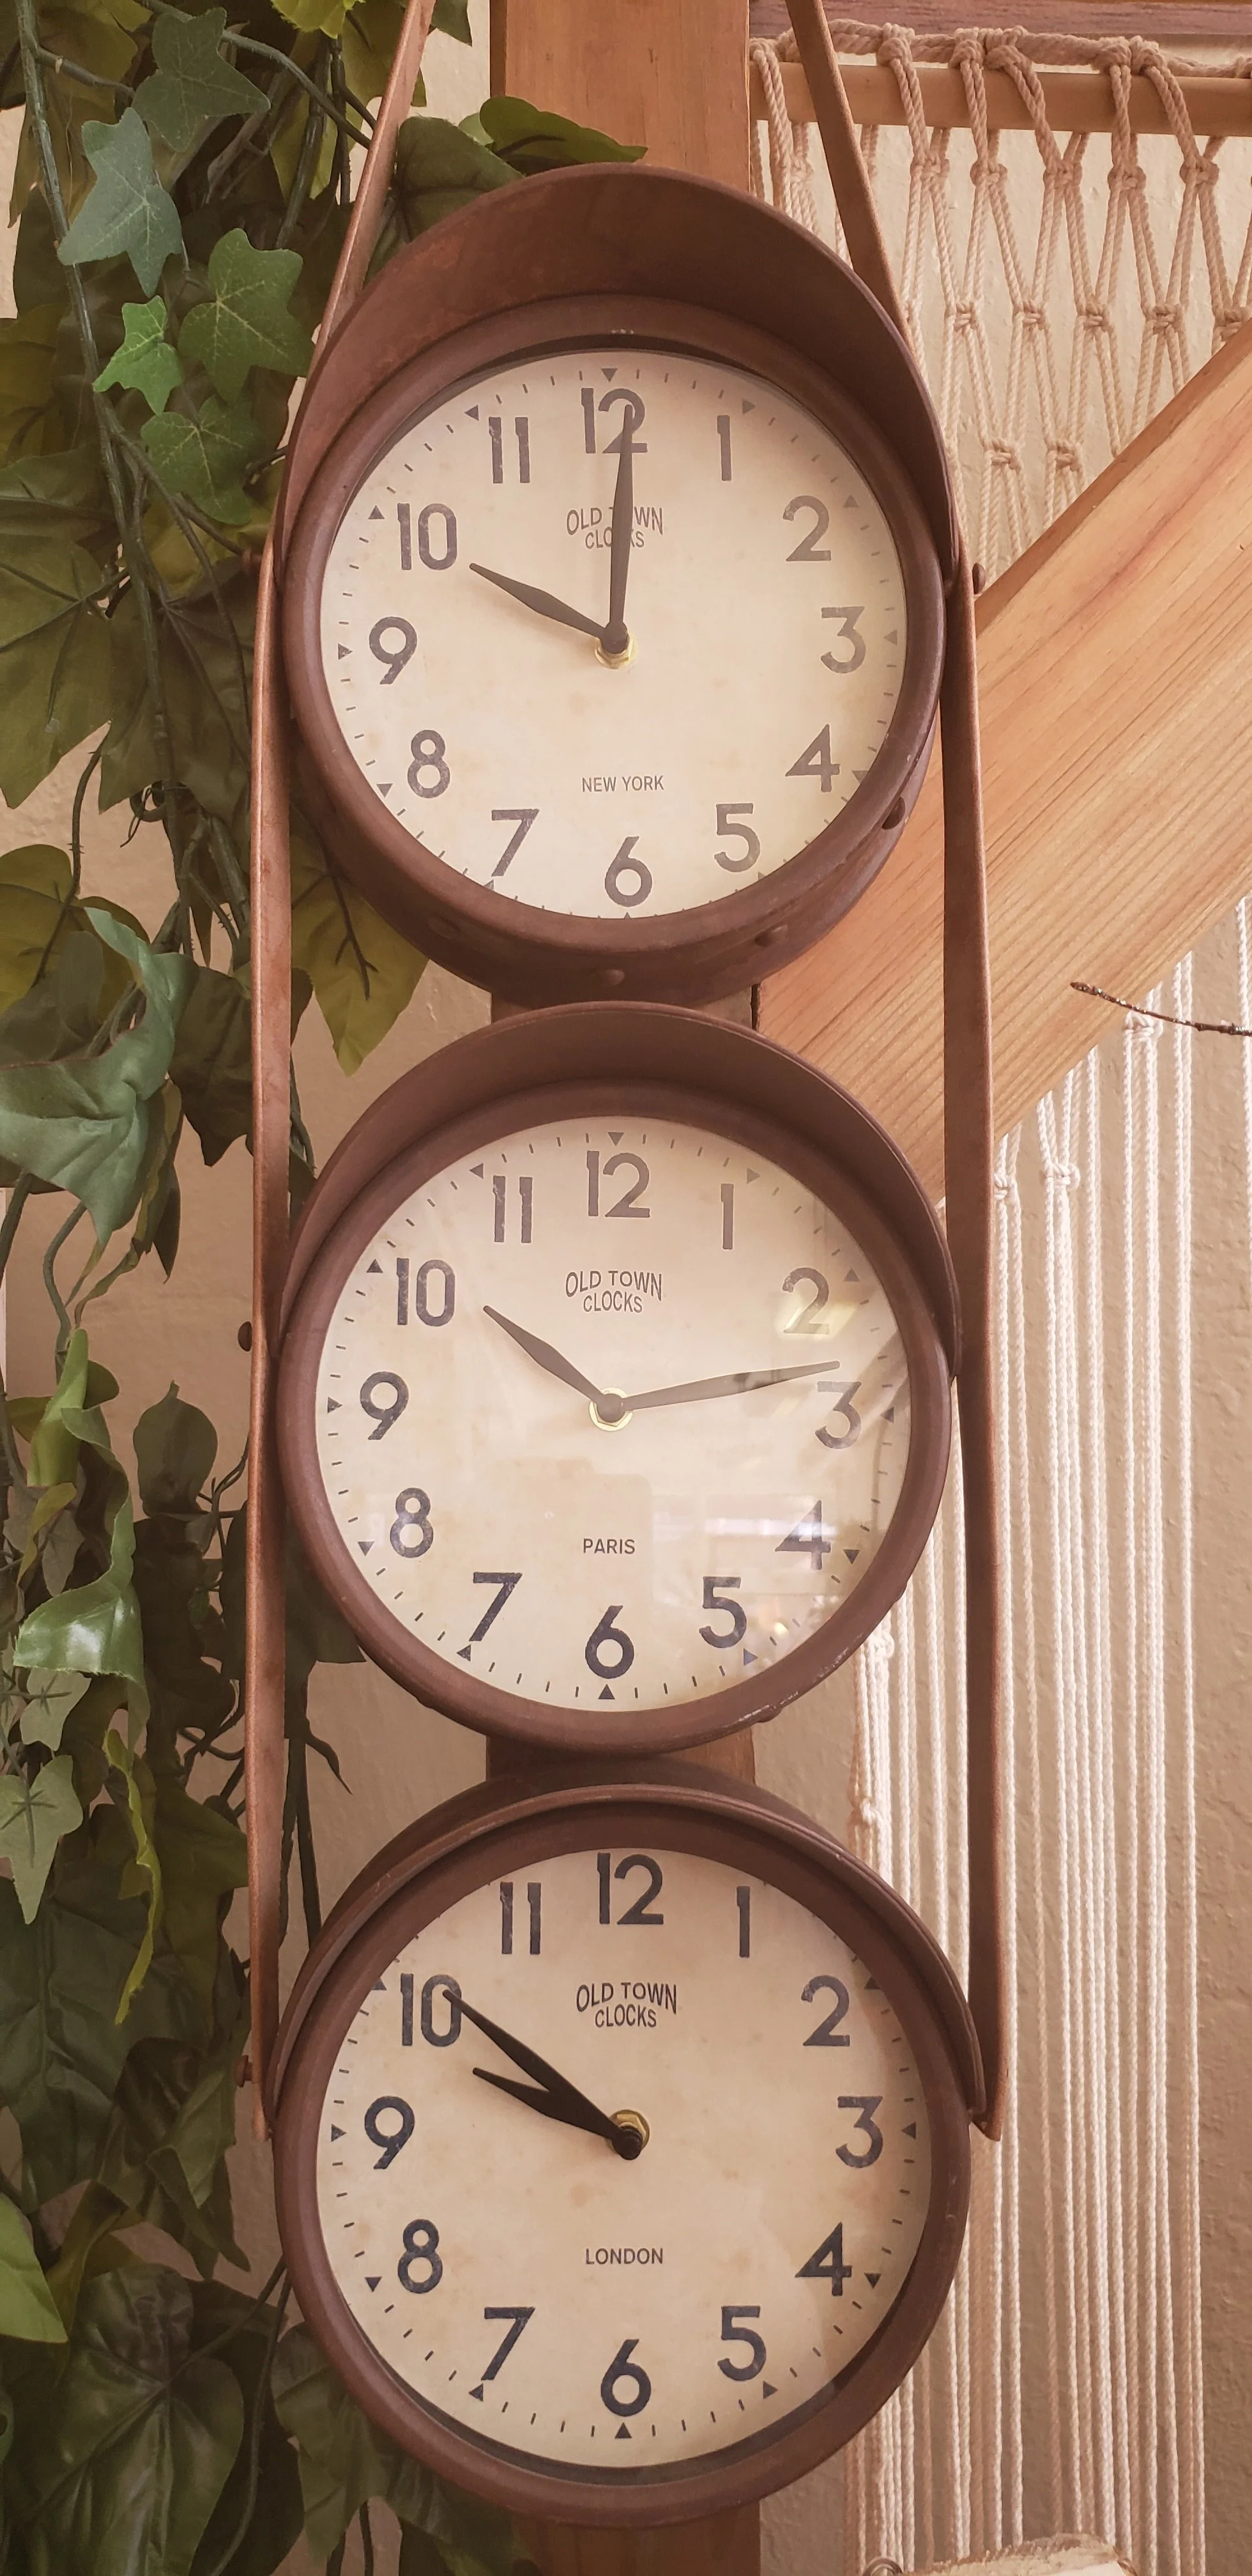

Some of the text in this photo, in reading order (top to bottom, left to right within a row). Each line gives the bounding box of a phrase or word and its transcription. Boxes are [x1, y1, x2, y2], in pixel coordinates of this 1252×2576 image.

[488, 417, 530, 484] 11
[581, 388, 648, 454] 12
[717, 415, 732, 481] 1
[397, 503, 457, 571] 10
[567, 507, 663, 535] OLD WN
[585, 526, 645, 549] CLOS
[782, 495, 832, 562] 2
[368, 616, 418, 685] 9
[820, 606, 866, 674] 3
[407, 729, 451, 799] 8
[581, 776, 664, 793] NEW YORK
[785, 724, 841, 793] 4
[491, 809, 539, 877] 7
[604, 836, 653, 907] 6
[714, 802, 760, 873] 5
[493, 1176, 532, 1244] 11
[586, 1150, 651, 1218] 12
[721, 1183, 734, 1250] 1
[395, 1258, 456, 1327] 10
[565, 1270, 662, 1301] OLD TOWN
[583, 1290, 643, 1314] CLOCKS
[781, 1267, 831, 1335] 2
[359, 1371, 409, 1441] 9
[815, 1381, 863, 1449] 3
[389, 1488, 434, 1558] 8
[583, 1538, 636, 1554] PARIS
[774, 1499, 831, 1570] 4
[468, 1572, 523, 1642] 7
[699, 1575, 747, 1649] 5
[584, 1605, 635, 1679] 6
[500, 1881, 541, 1954] 11
[597, 1853, 664, 1925] 12
[736, 1885, 751, 1958] 1
[400, 1974, 462, 2047] 10
[576, 1982, 676, 2014] OLD TOWN
[595, 2004, 657, 2028] CLOCKS
[801, 1975, 851, 2046] 2
[363, 2096, 415, 2170] 9
[835, 2096, 884, 2168] 3
[397, 2219, 443, 2294] 8
[585, 2248, 664, 2265] LONDON
[795, 2222, 852, 2296] 4
[480, 2306, 536, 2381] 7
[717, 2305, 767, 2381] 5
[600, 2339, 652, 2418] 6
